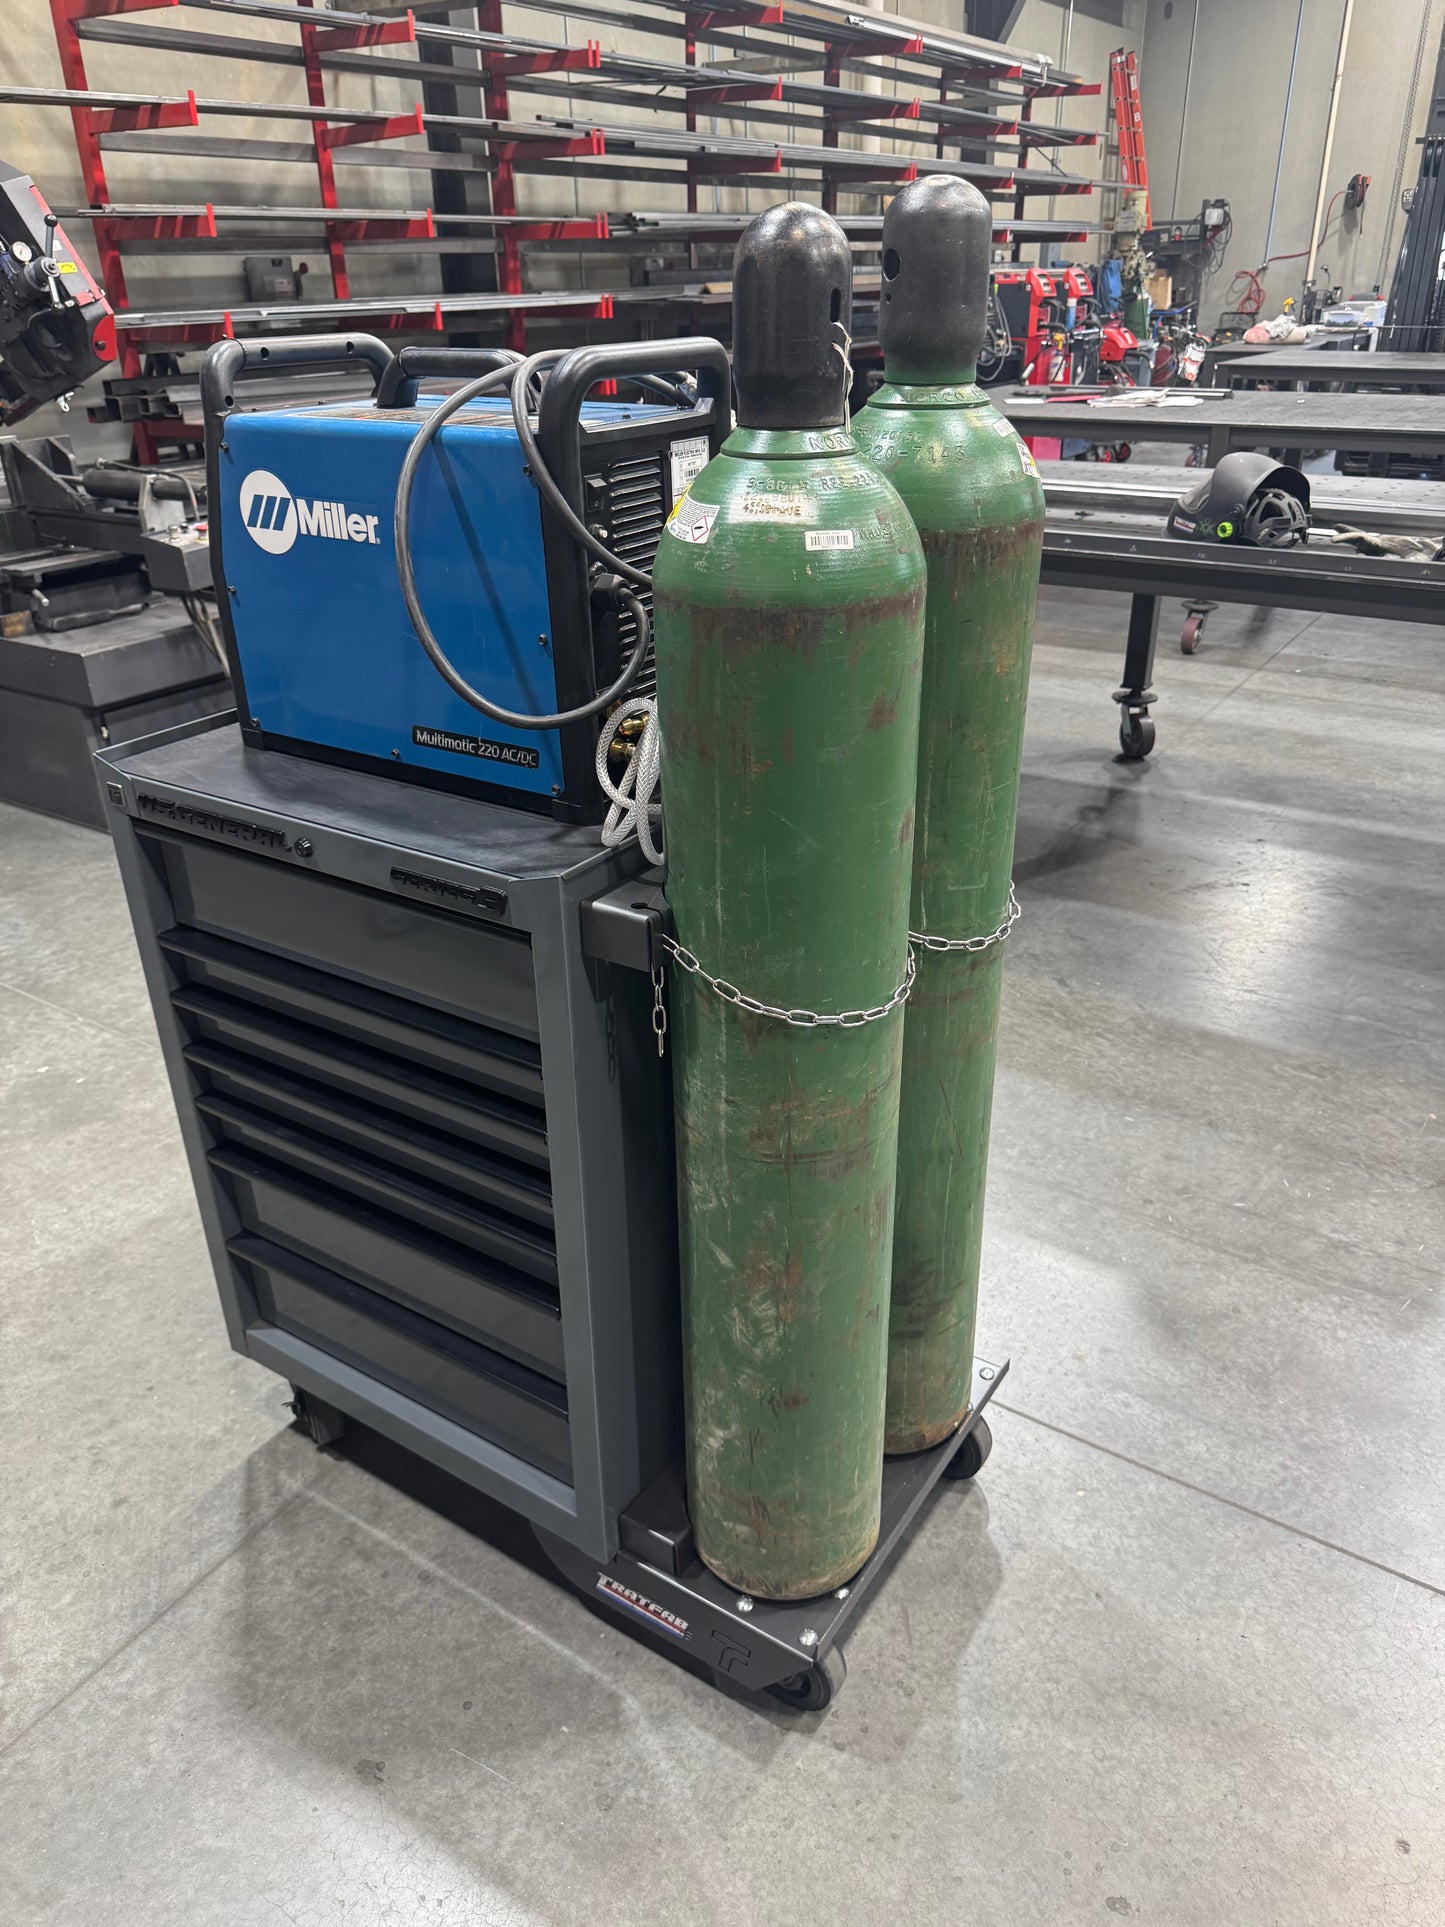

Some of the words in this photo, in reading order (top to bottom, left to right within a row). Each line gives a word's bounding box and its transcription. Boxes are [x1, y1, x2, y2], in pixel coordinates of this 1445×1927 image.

[296, 498, 378, 544] Miller
[416, 730, 475, 754] Multimatic
[478, 742, 500, 758] 220
[501, 747, 537, 766] AC/DC
[598, 1571, 689, 1630] TRATFAB
